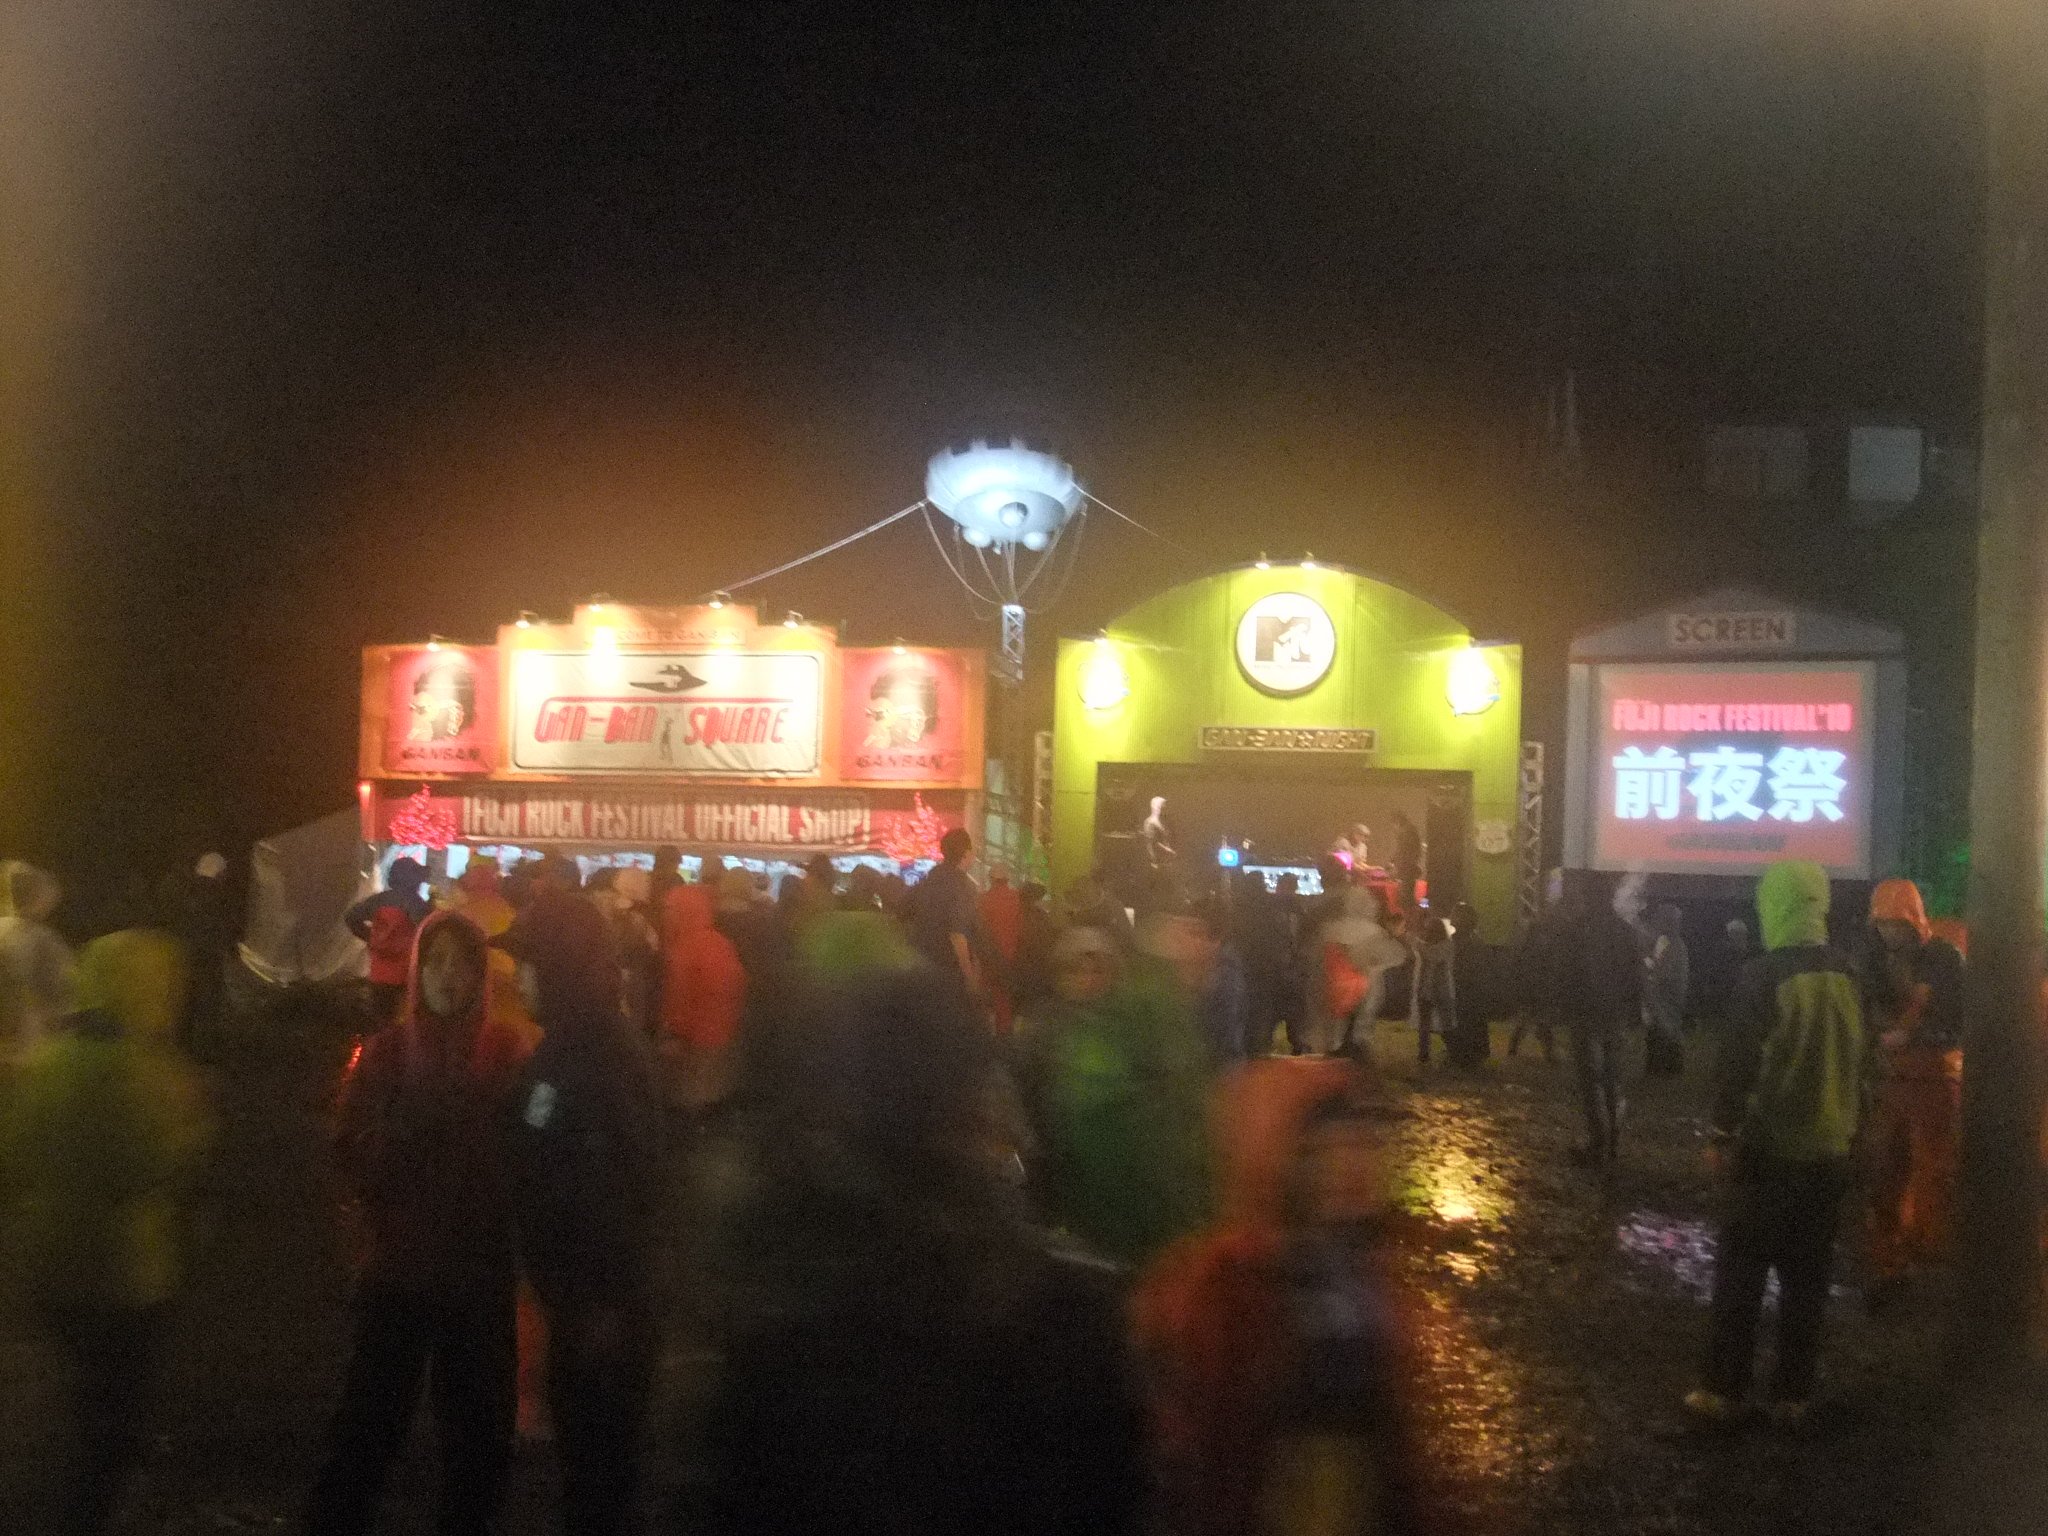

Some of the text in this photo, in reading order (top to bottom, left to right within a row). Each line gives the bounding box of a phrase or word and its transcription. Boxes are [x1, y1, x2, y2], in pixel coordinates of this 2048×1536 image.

[1675, 616, 1784, 642] SCREEN
[534, 702, 789, 748] GAN-BAN SQUARE
[1663, 703, 1722, 732] ROCK
[1612, 745, 1848, 822] 前夜祭
[525, 799, 584, 839] ROCK
[591, 801, 687, 841] FESTIVAL
[694, 803, 793, 842] OFFICIAL
